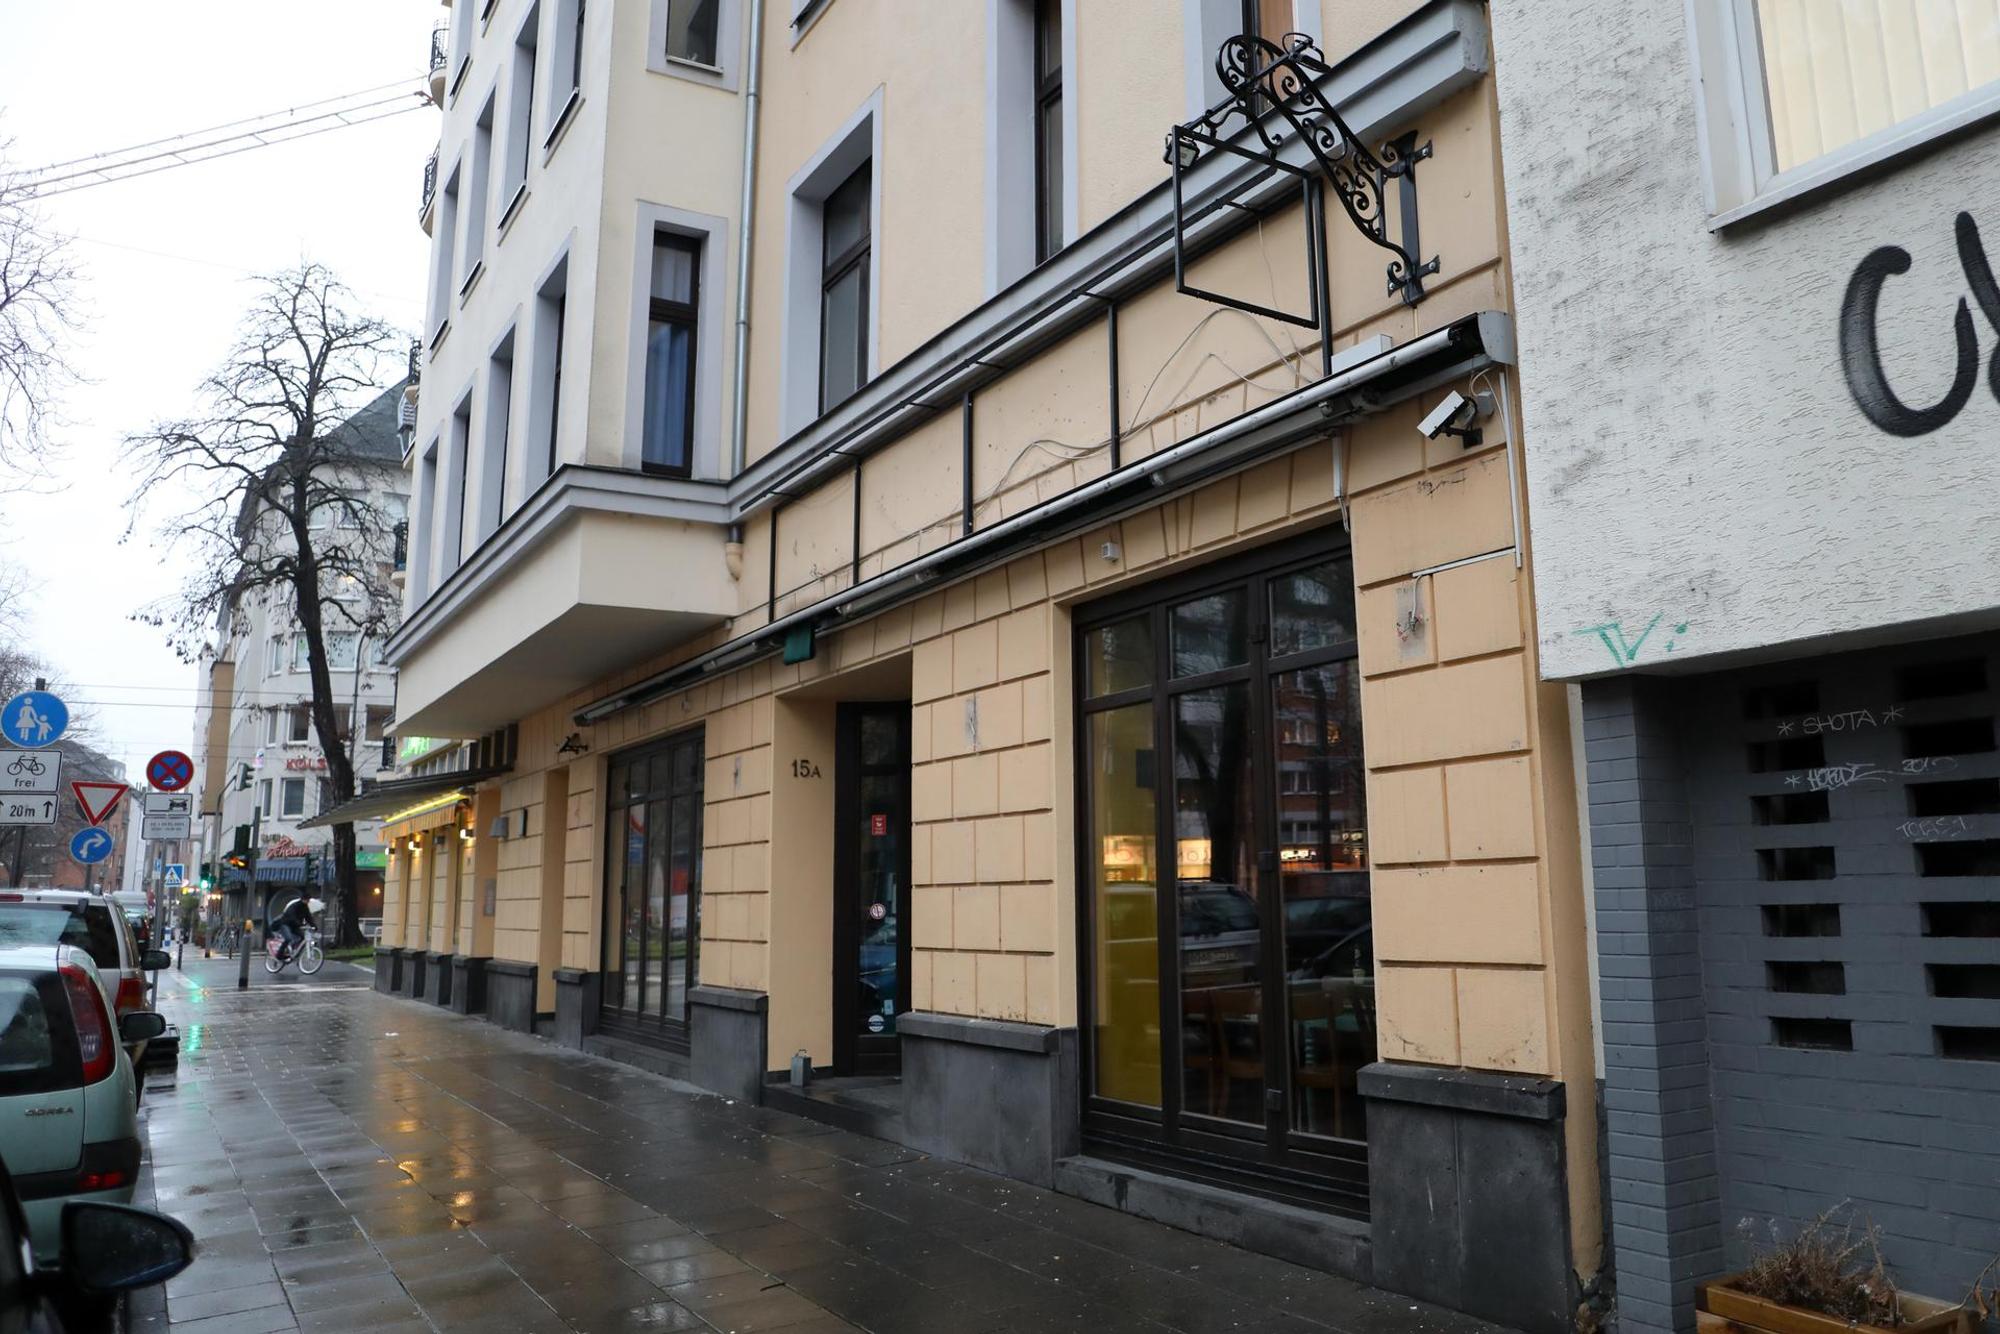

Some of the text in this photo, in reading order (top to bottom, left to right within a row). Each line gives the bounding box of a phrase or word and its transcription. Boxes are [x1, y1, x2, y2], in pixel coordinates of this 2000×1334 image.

[1803, 709, 1877, 734] SHOTA
[791, 759, 821, 778] 15A
[15, 778, 36, 787] frei
